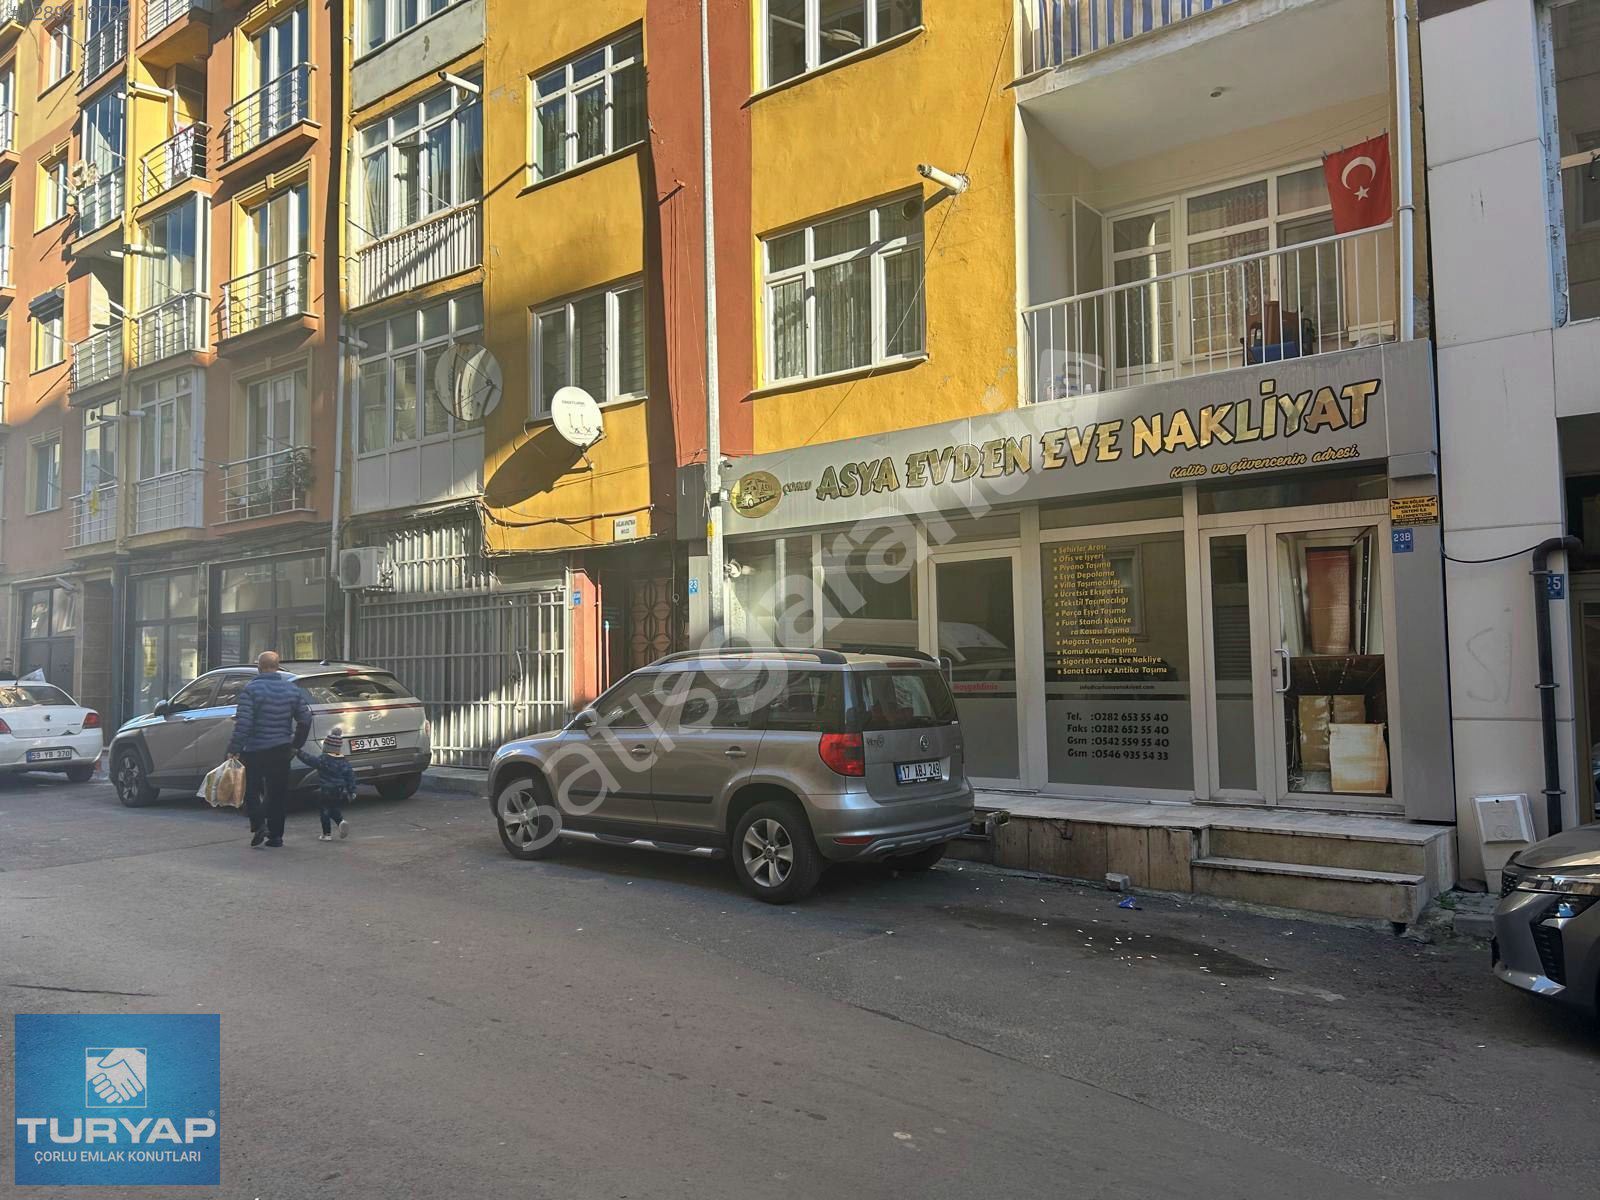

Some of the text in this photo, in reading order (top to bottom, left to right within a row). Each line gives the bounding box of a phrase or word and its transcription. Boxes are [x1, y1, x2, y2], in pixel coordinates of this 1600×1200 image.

[816, 456, 900, 501] ASYA
[905, 434, 1032, 489] EVDEN
[1040, 419, 1123, 470] EVE
[1132, 379, 1382, 458] NAKLİYAT
[1170, 464, 1207, 479] Kalite
[1211, 462, 1228, 474] ve
[1229, 453, 1306, 475] güvencenin
[1393, 532, 1411, 542] 23B
[1077, 570, 1115, 579] Depolama
[1104, 616, 1132, 625] Nakliye
[1132, 655, 1162, 664] Nakliye
[1063, 667, 1084, 675] Sanat
[1086, 666, 1103, 674] Eseri
[1113, 666, 1139, 674] Antika
[1067, 712, 1082, 720] Tel.
[1121, 713, 1138, 721] 653
[1140, 713, 1151, 721] 55
[1154, 713, 1168, 722] 40
[1067, 724, 1087, 733] Faks
[1121, 725, 1138, 734] 652
[1141, 726, 1152, 734] 55
[1154, 726, 1169, 735] 40
[356, 737, 395, 749] 59 YA 905
[1067, 736, 1087, 745] Gsm
[1121, 738, 1139, 746] 559
[1141, 738, 1152, 747] 55
[1154, 739, 1169, 747] 40
[1067, 748, 1087, 758] Gsm
[1123, 750, 1140, 760] 935
[1143, 751, 1155, 760] 54
[1157, 752, 1169, 761] 33
[902, 763, 940, 779] 17 ABJ 249
